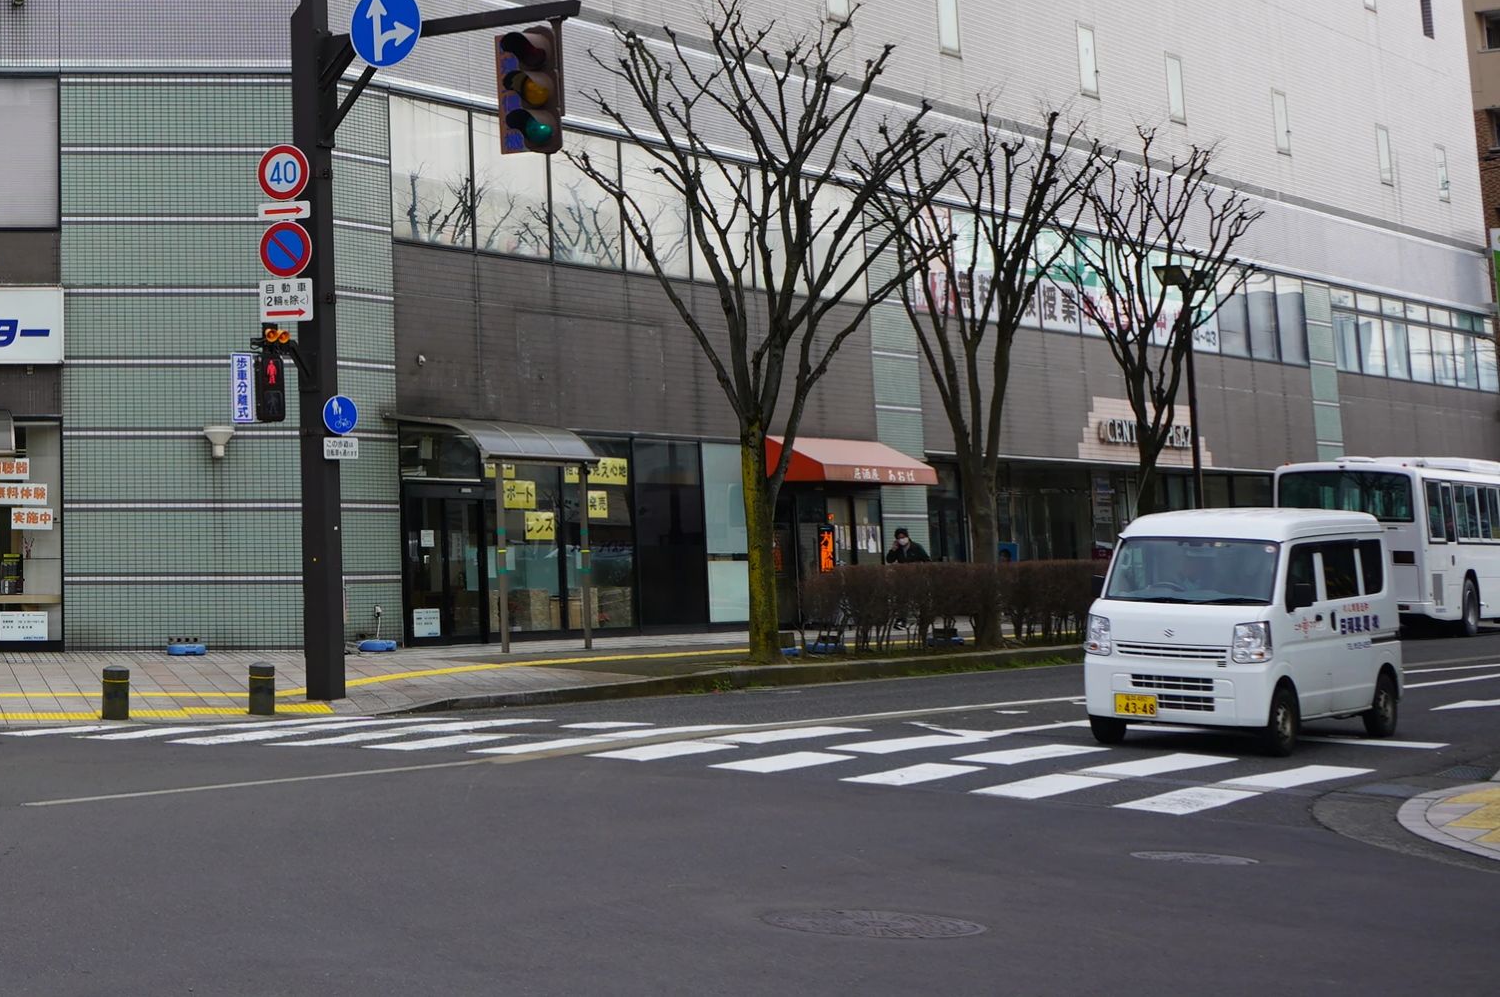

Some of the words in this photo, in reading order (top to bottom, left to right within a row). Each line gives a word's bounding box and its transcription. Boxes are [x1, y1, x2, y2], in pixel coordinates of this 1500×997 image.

[269, 160, 297, 185] 40
[265, 282, 307, 294] 自動車
[235, 357, 250, 420] 歩車分離式
[853, 467, 880, 481] 居酒屋
[12, 511, 52, 524] 実施中
[1124, 702, 1155, 715] 43-48
